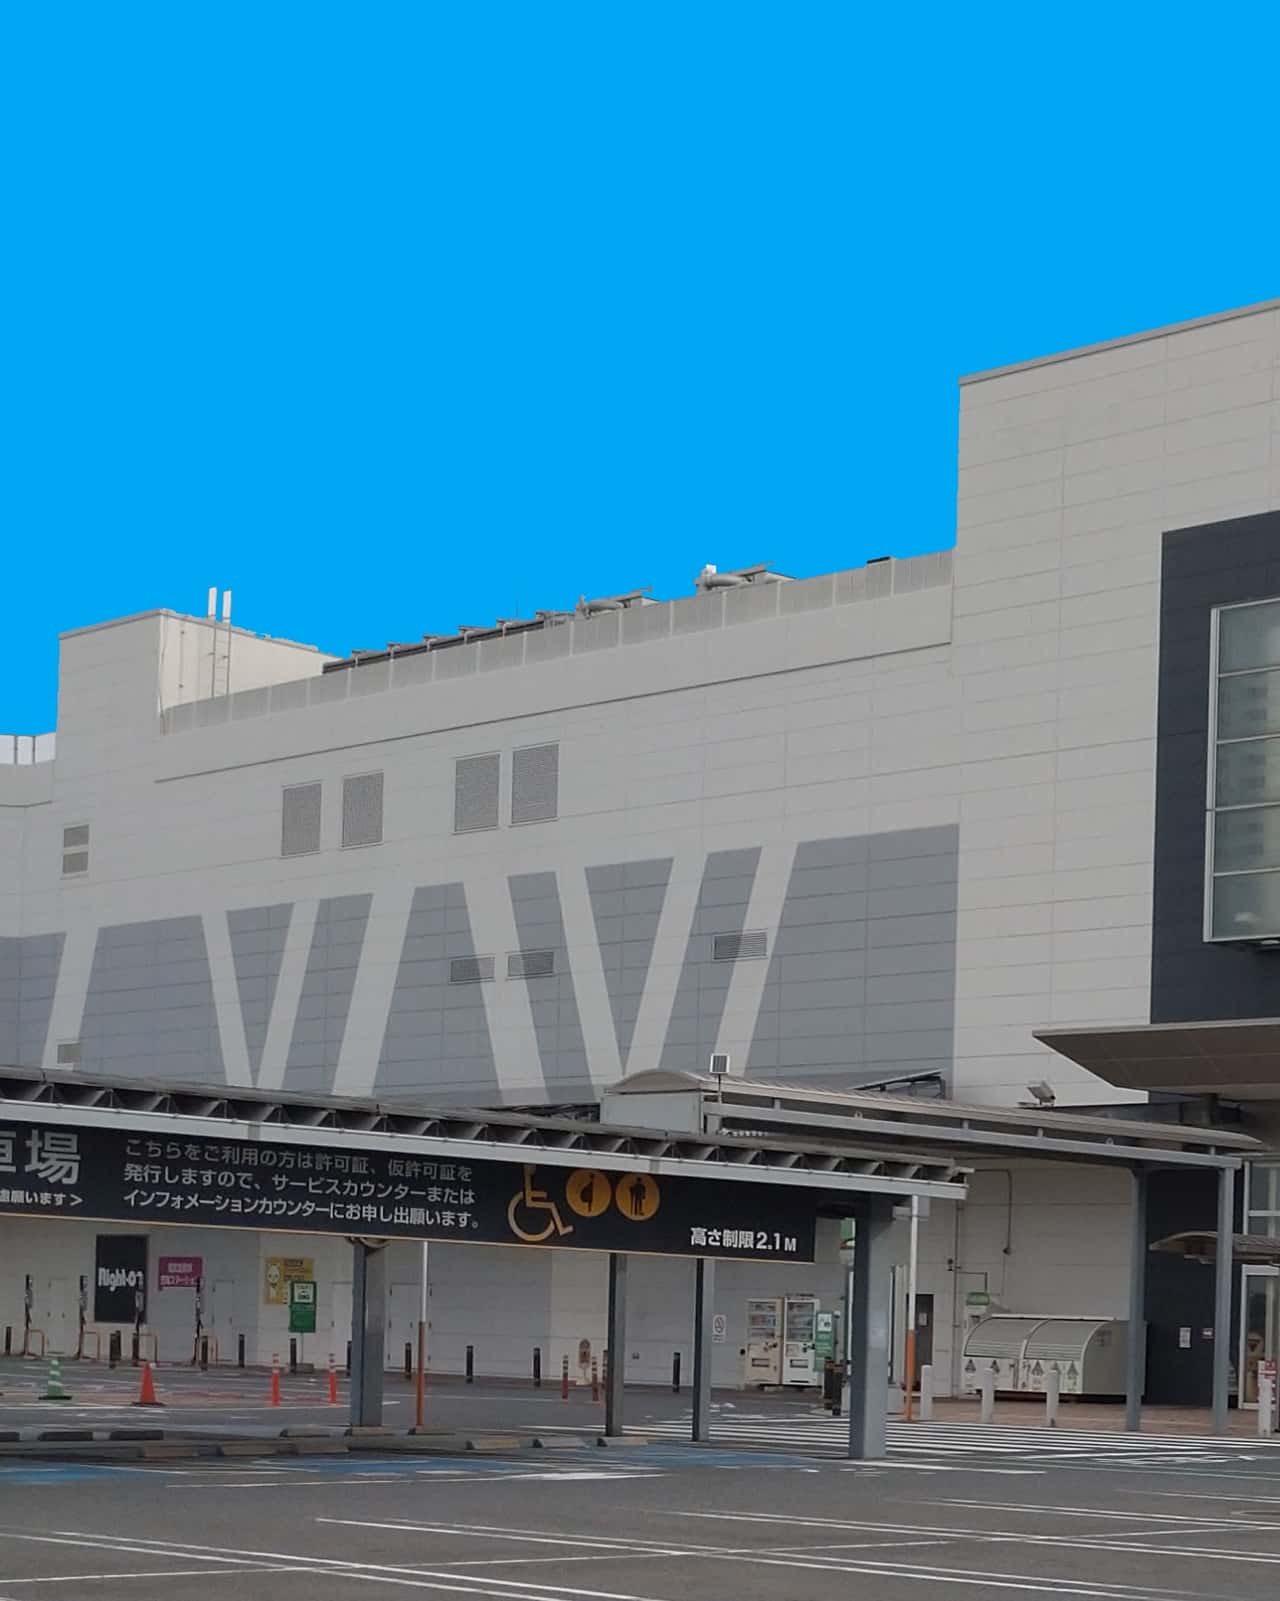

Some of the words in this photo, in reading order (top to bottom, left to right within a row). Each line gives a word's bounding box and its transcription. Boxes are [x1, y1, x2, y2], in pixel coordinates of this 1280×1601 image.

[126, 1139, 473, 1182] こちらをご利用の方は許可証、仮許可証を
[124, 1163, 475, 1205] 発行しますので、サービスカウンターまたは
